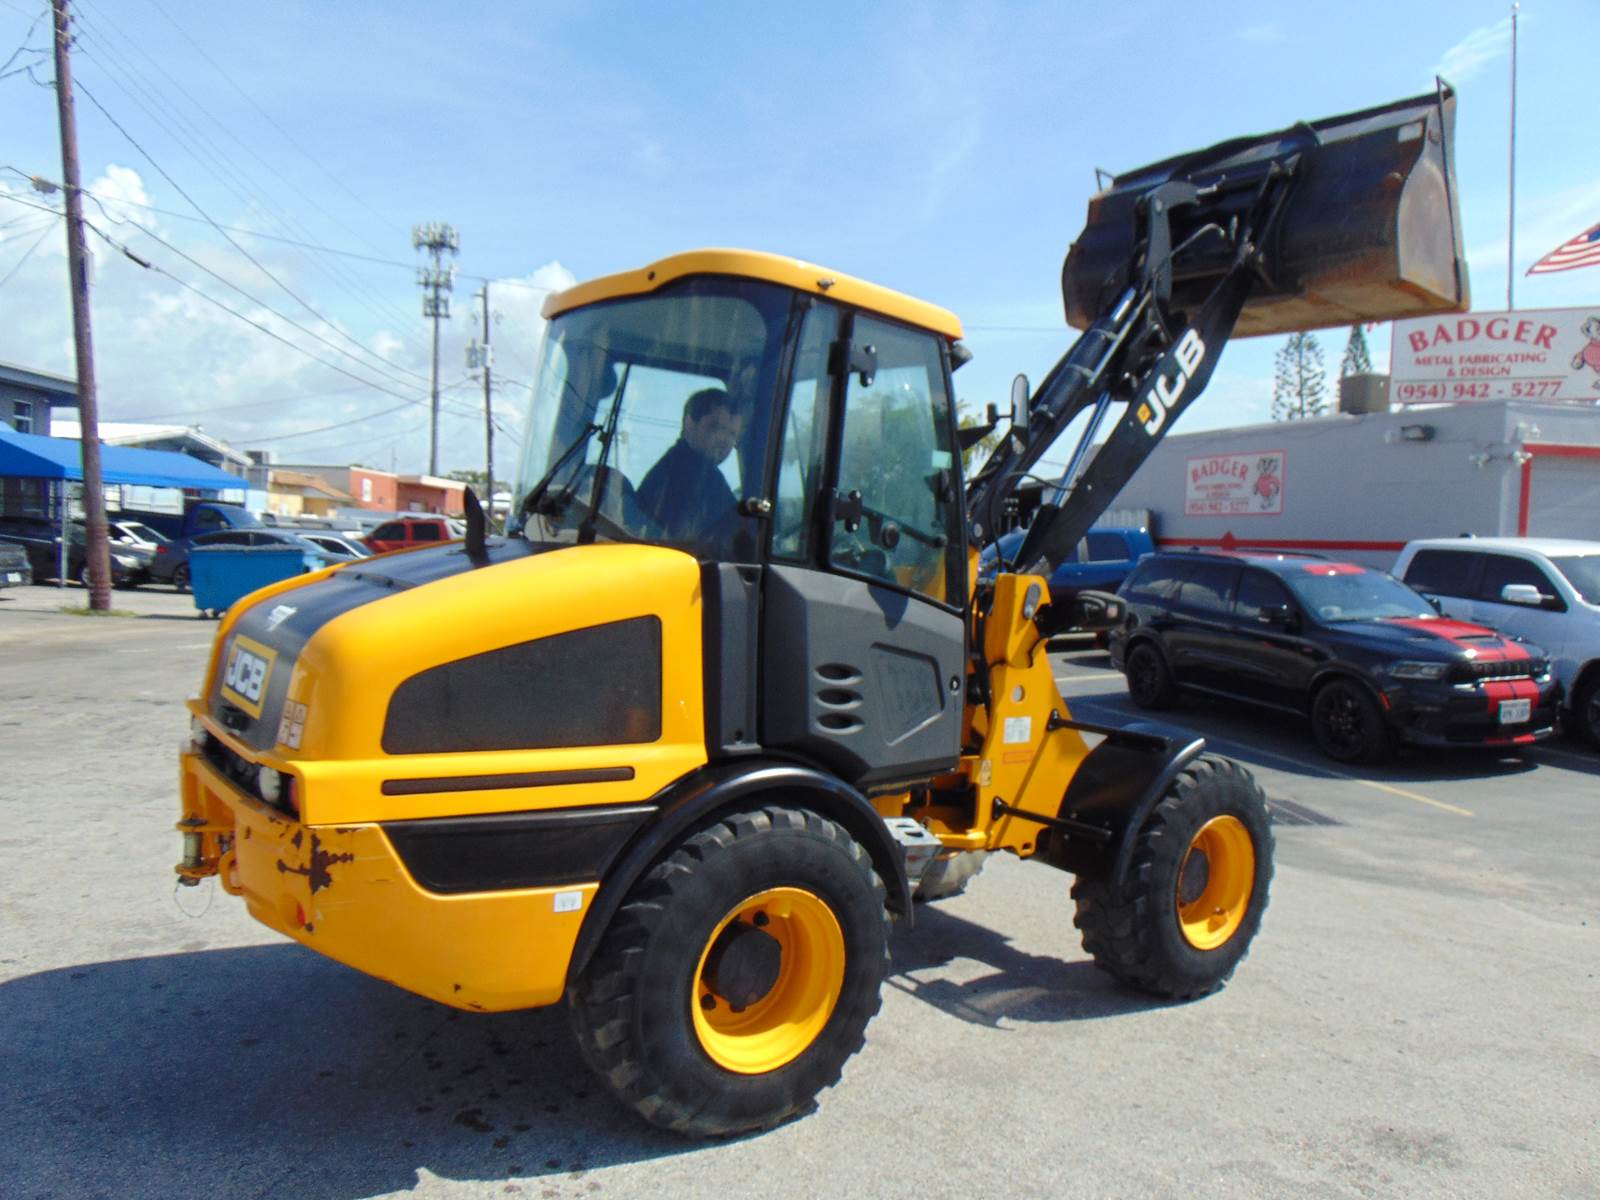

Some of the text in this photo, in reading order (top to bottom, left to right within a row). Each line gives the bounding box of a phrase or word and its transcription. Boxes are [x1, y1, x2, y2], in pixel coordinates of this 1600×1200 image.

[1408, 317, 1558, 353] BADGER
[1414, 352, 1547, 366] METAL FABRICATING
[1143, 328, 1206, 436] JCB
[1460, 366, 1511, 377] DESIGN
[1397, 382, 1447, 399] (954)
[1453, 382, 1490, 398] 942
[1511, 381, 1563, 397] 5277
[1191, 459, 1249, 482] BADGER
[226, 649, 268, 703] JCB
